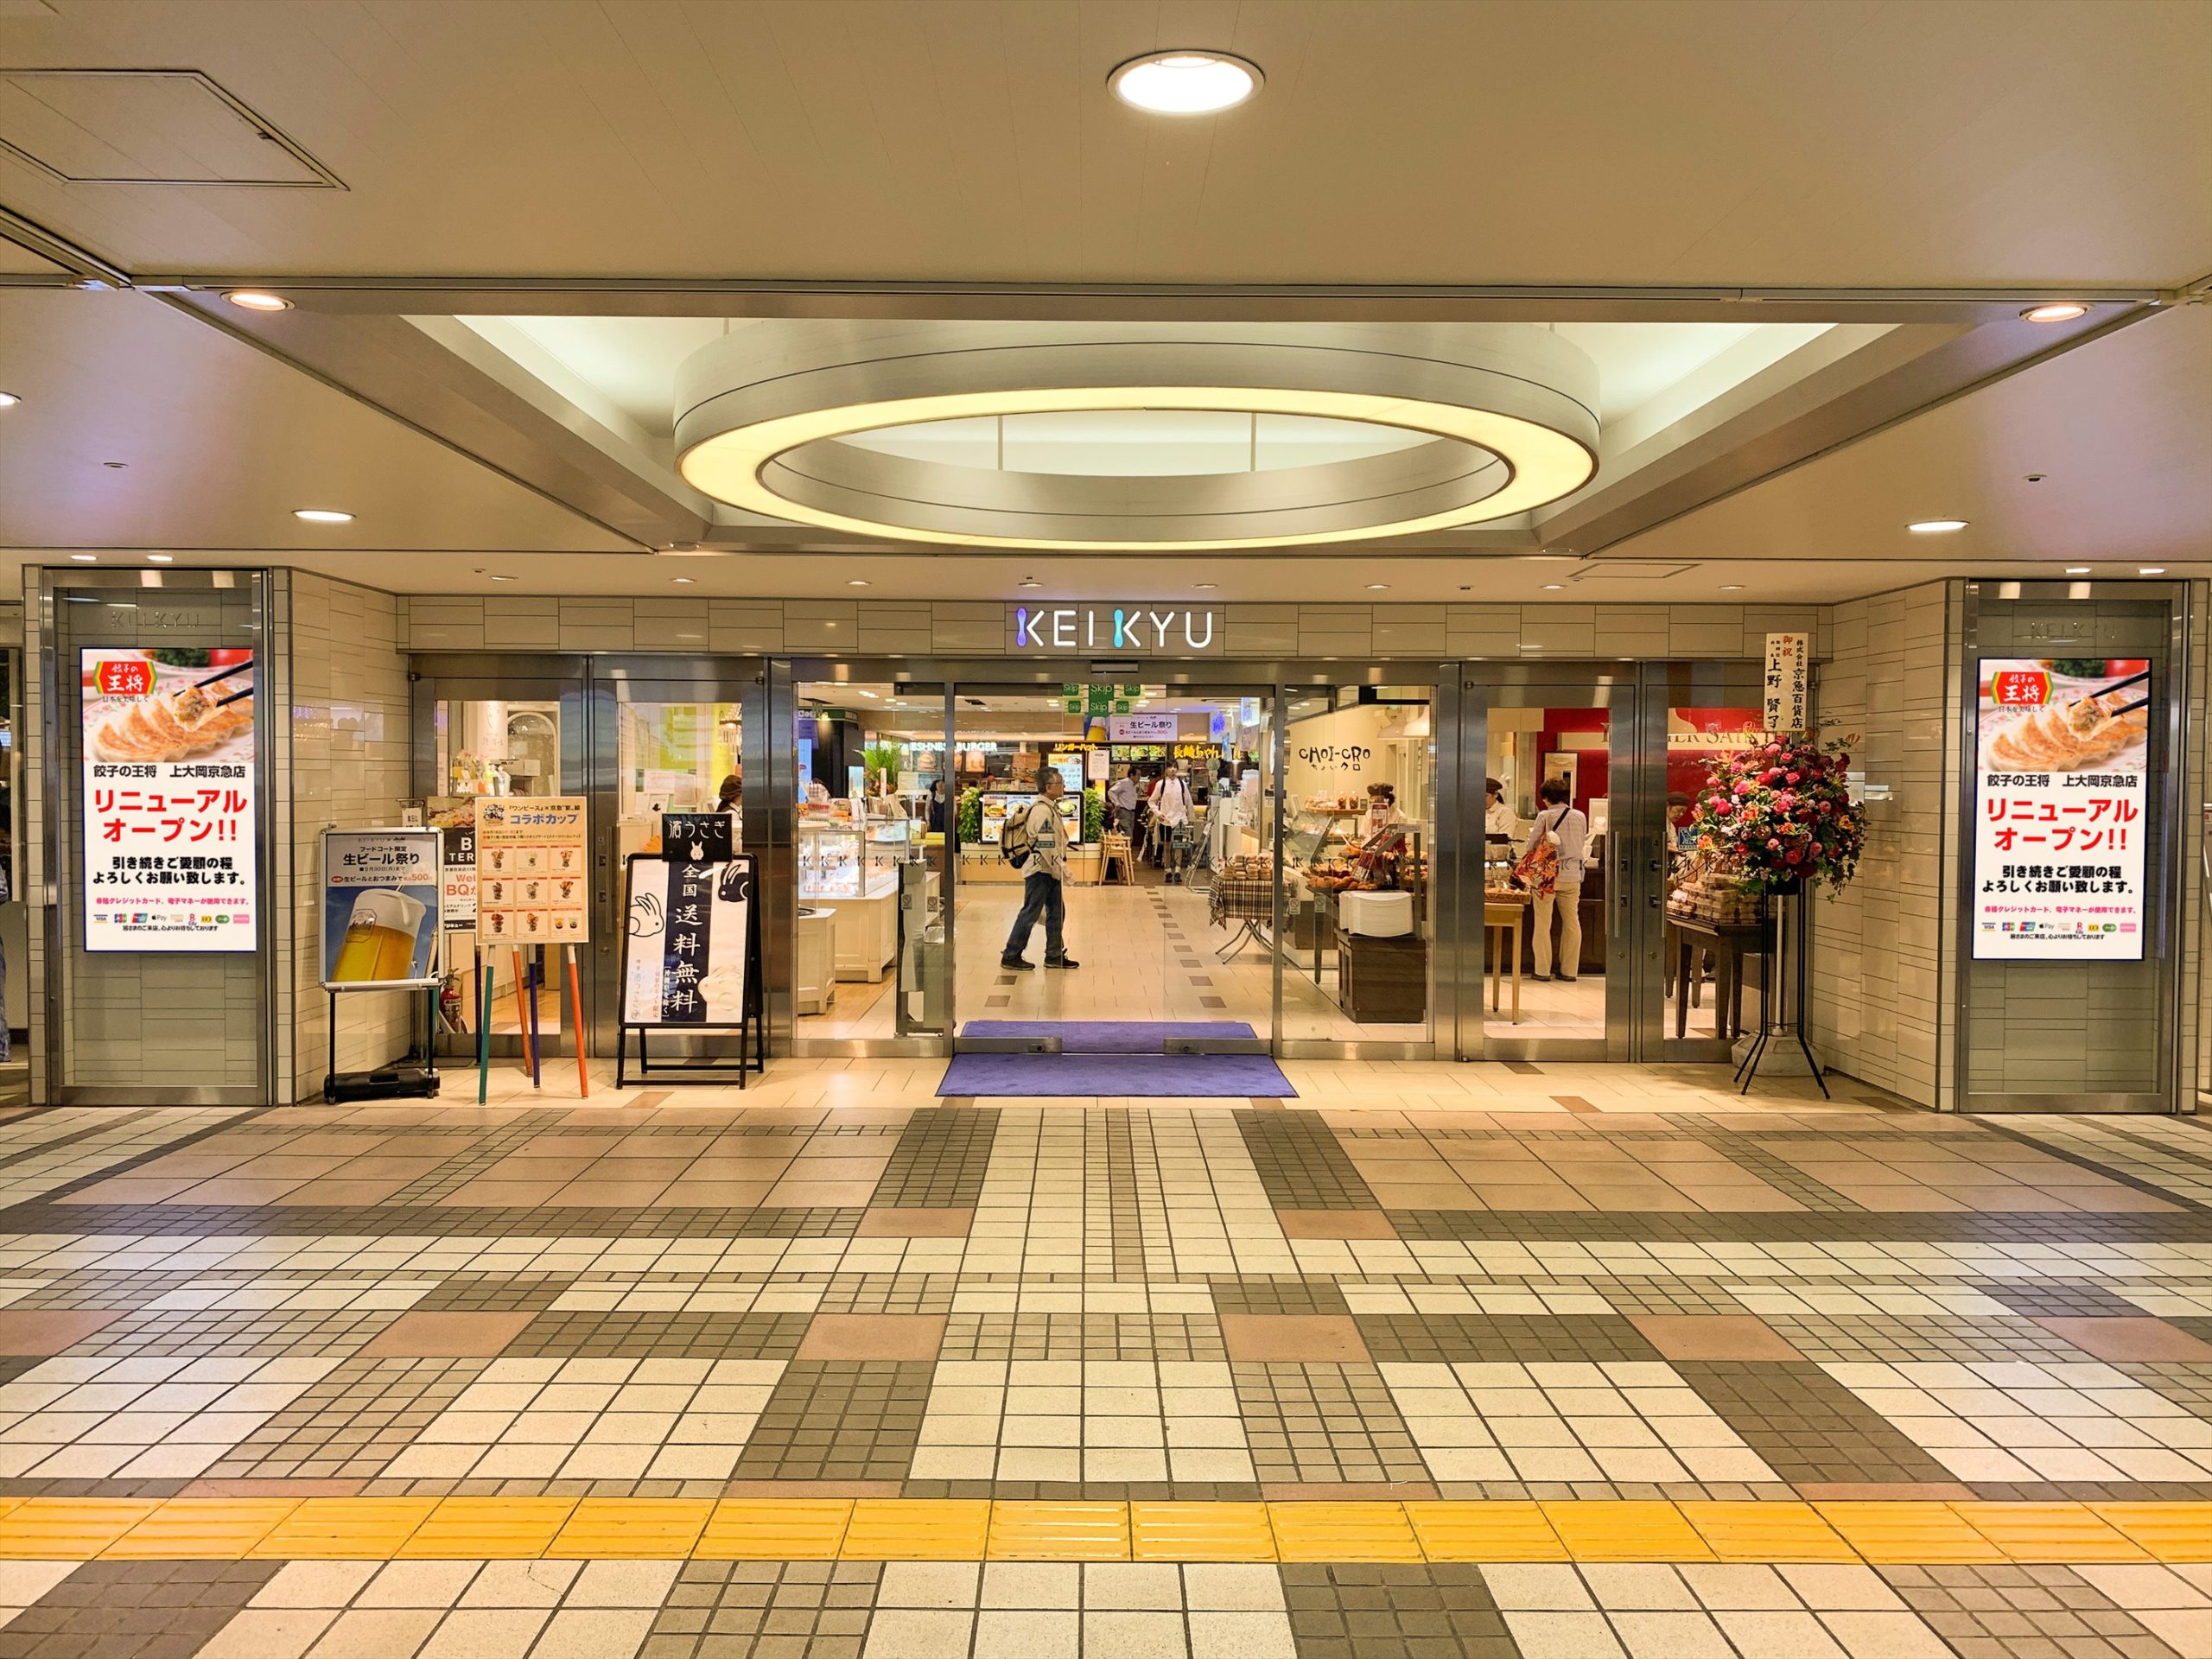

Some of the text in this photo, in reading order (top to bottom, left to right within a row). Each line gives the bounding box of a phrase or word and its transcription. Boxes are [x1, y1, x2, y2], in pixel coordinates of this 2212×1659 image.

[1016, 607, 1212, 648] KEIKYU
[111, 664, 138, 673] 餃子の
[107, 674, 144, 692] 王将
[2009, 673, 2035, 683] 餃子の
[2004, 685, 2040, 702] 王将
[957, 741, 998, 752] BURGER
[93, 765, 245, 778] 餃子の王将 上大岡京急店
[1987, 774, 2138, 787] 餃子の王将 上大岡京急店
[95, 790, 247, 813] リニューアル
[1987, 798, 2138, 823] リニューアル
[112, 856, 233, 870] 引き続きご愛顧の程
[343, 853, 420, 866] 生ビール祭り
[92, 871, 245, 885] よろしくお願い致します。
[2002, 865, 2122, 879] 引き続きご愛顧の程
[1982, 880, 2133, 893] よろしくお願い致します。
[671, 864, 703, 1014] 全国送料無料
